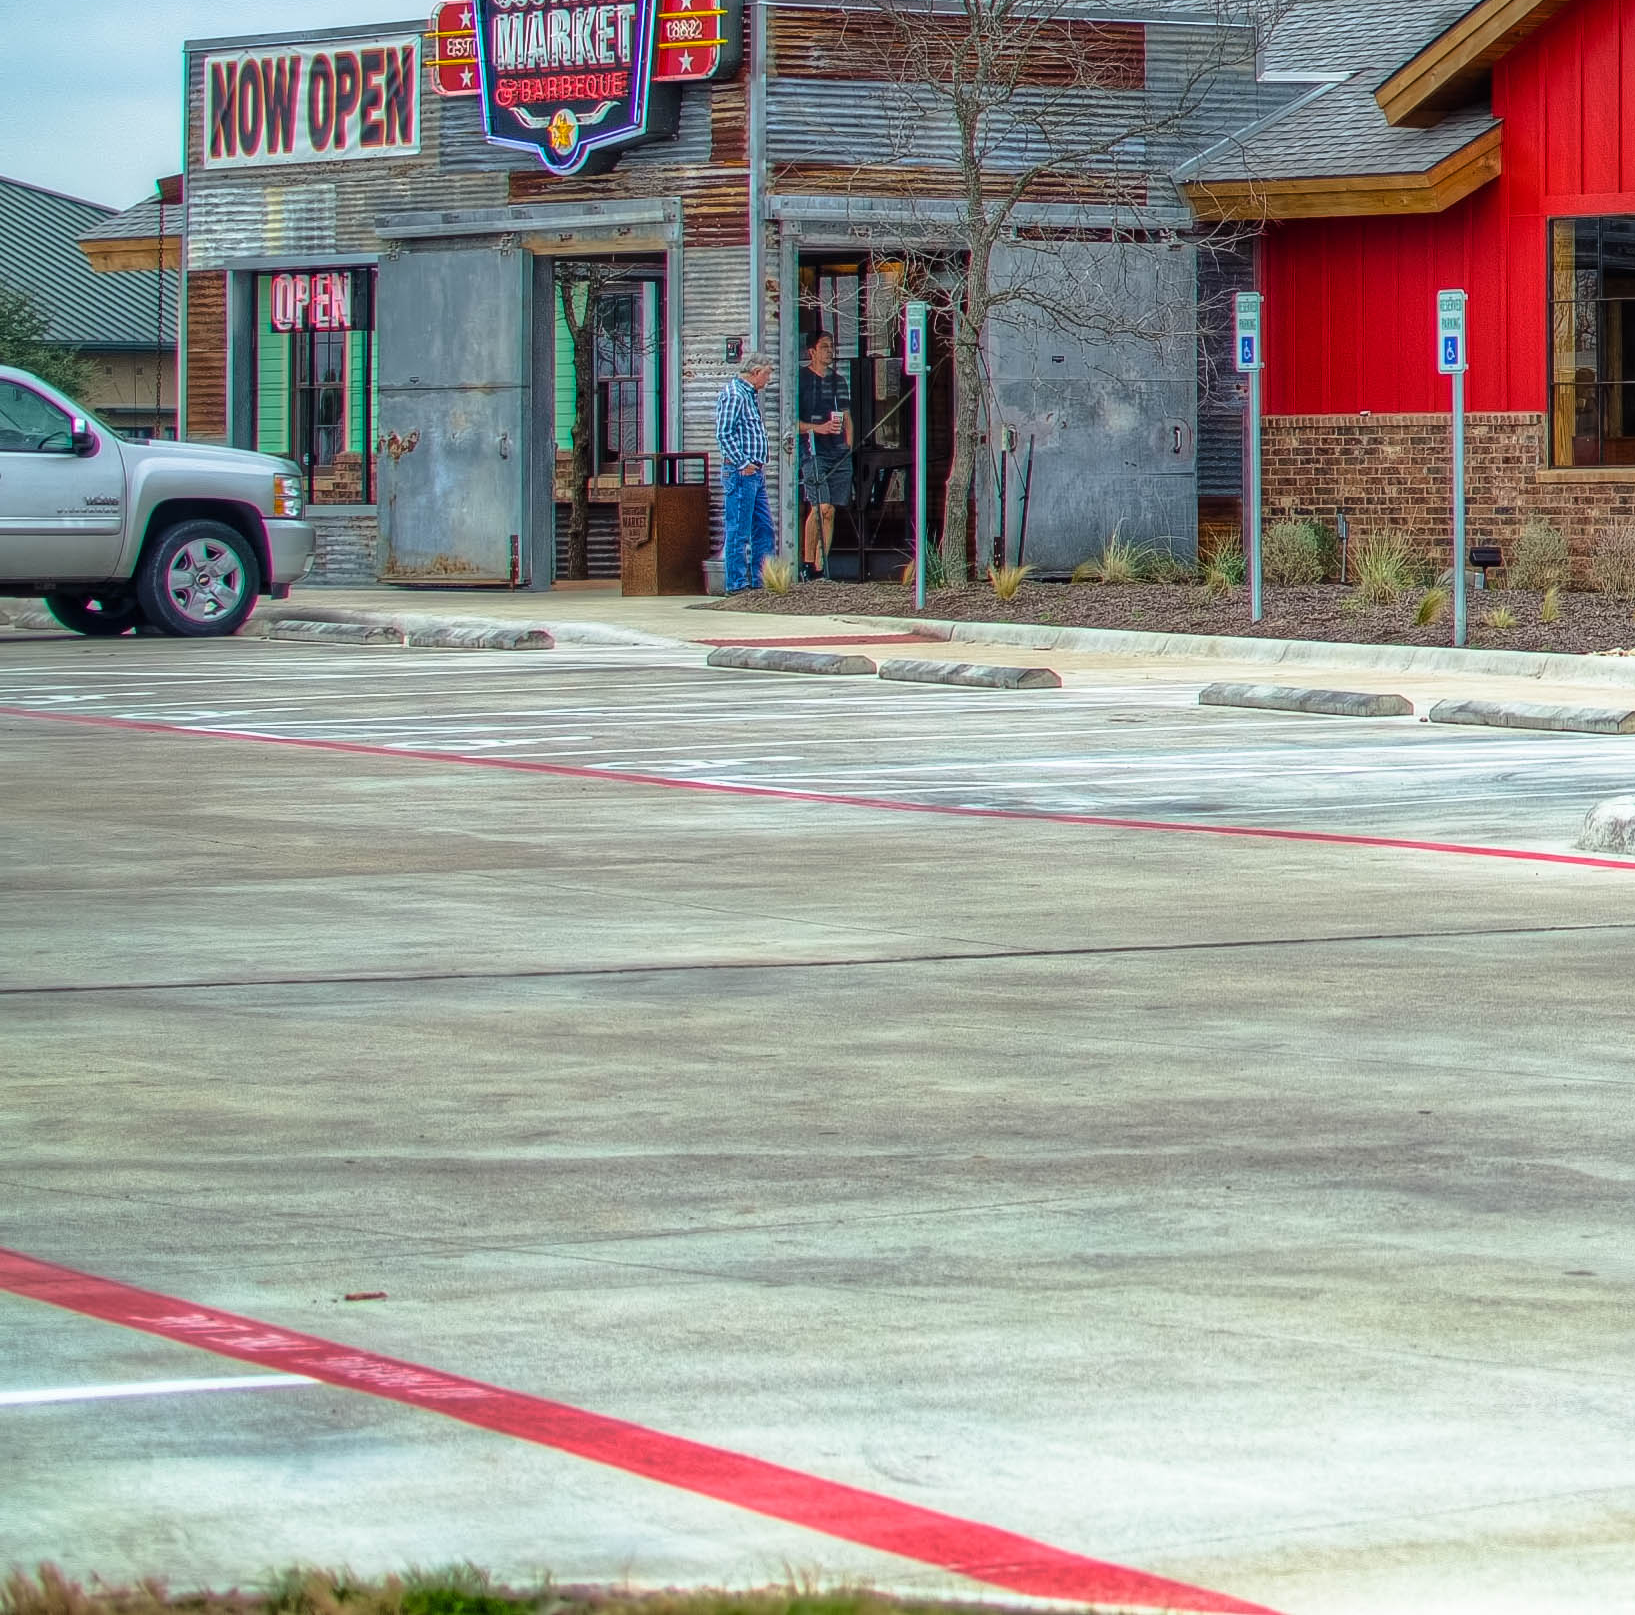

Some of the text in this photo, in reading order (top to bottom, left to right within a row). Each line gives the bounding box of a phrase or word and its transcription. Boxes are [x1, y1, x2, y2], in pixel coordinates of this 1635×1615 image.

[494, 3, 637, 72] MARKET
[666, 18, 703, 41] 1882
[210, 45, 415, 159] NOW OPEN
[521, 72, 631, 104] BARBEQUE
[271, 272, 352, 330] OPEN
